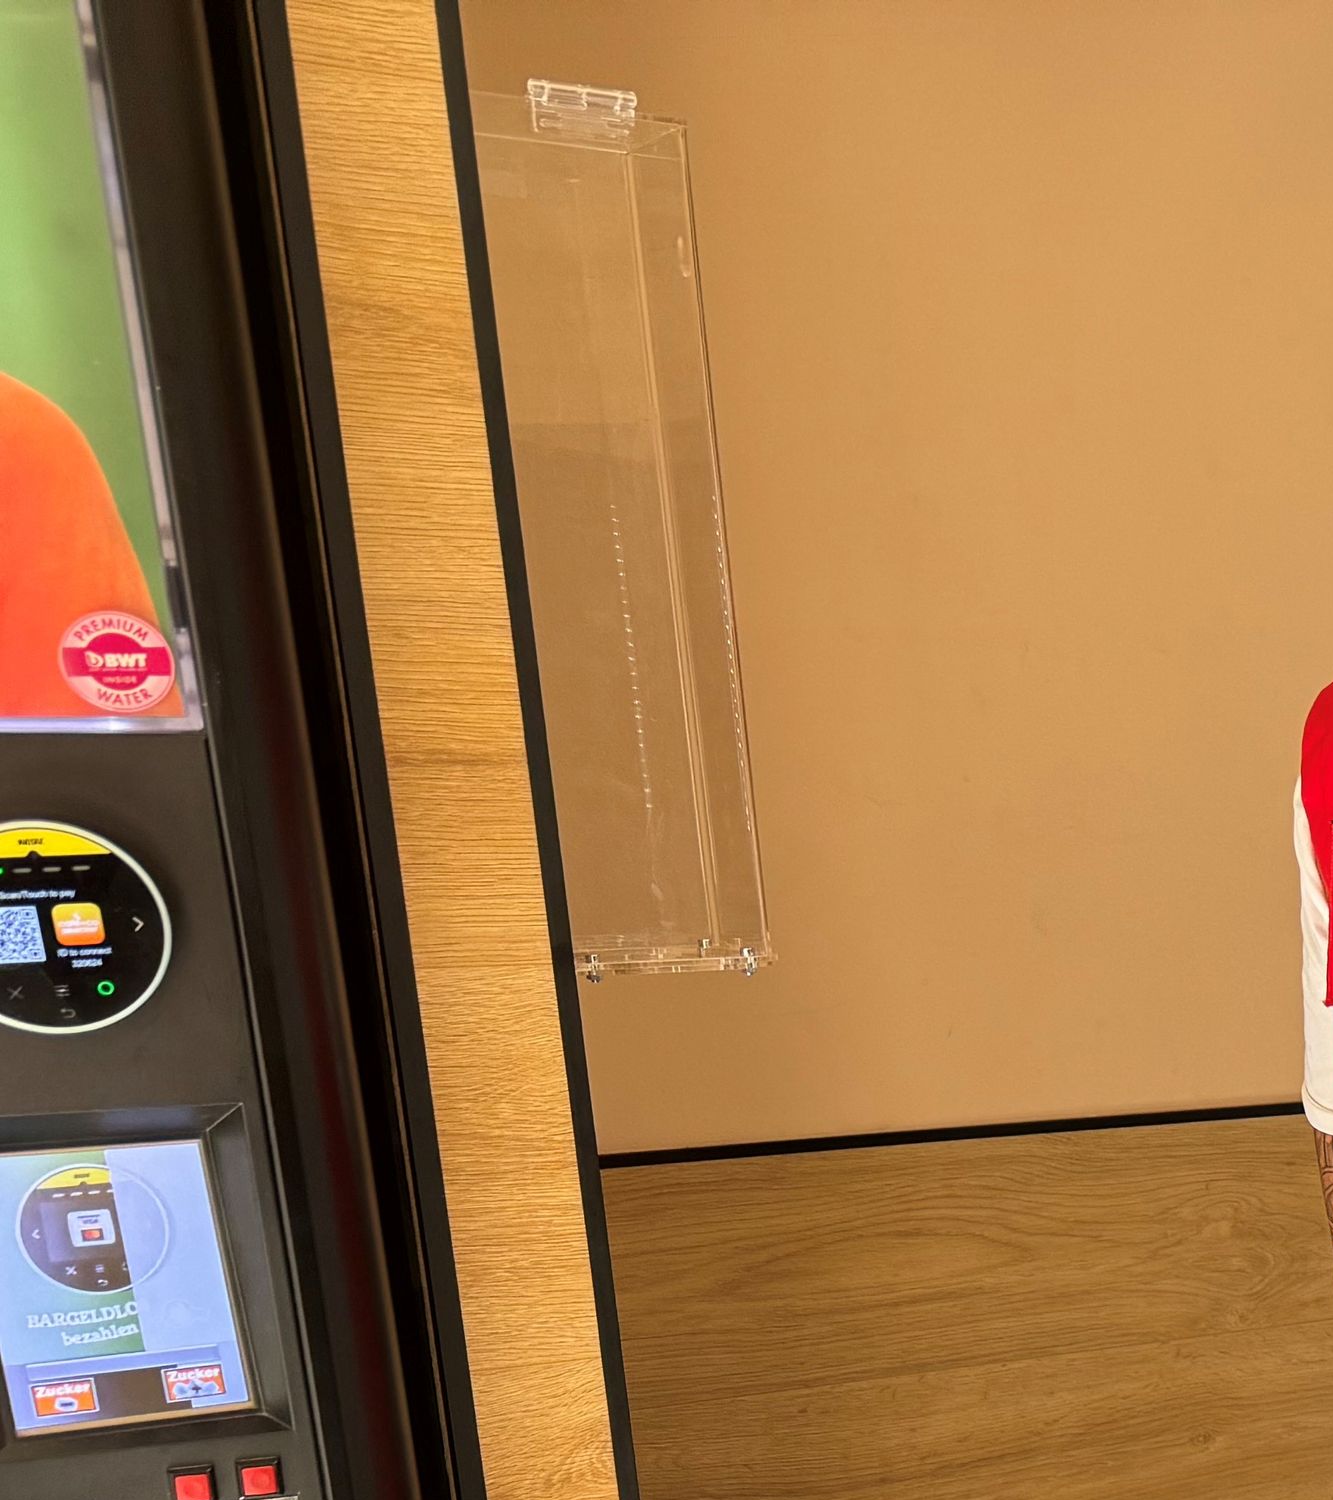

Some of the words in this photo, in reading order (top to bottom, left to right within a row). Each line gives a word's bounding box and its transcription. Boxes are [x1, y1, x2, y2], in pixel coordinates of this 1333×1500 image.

[73, 618, 149, 642] PREMIUM
[97, 688, 152, 706] WATER
[26, 1302, 143, 1328] BARGELDLO
[61, 1324, 139, 1346] bezahlen
[167, 1366, 220, 1382] Zucker
[34, 1383, 92, 1399] Zucker
